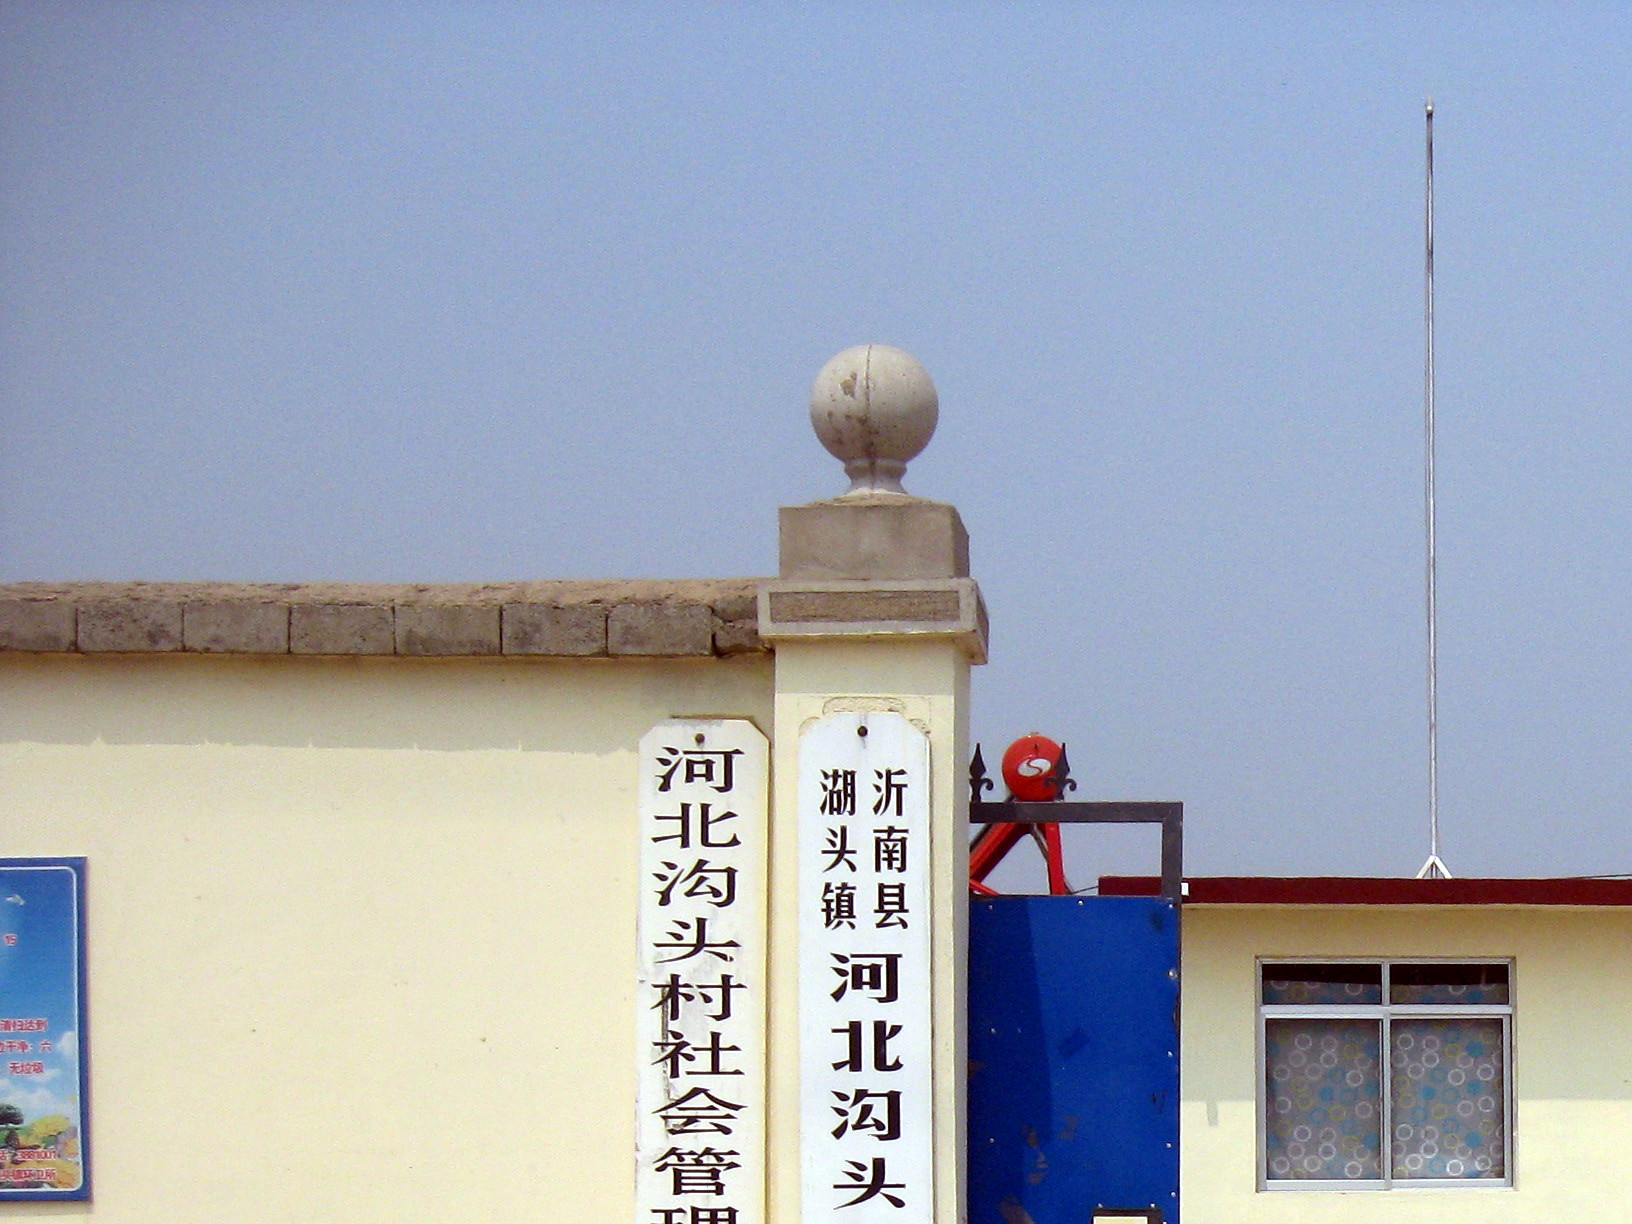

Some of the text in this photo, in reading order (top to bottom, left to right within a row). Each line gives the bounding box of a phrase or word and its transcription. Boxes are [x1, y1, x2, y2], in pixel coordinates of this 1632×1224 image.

[819, 768, 858, 931] 湖头镇
[872, 768, 910, 930] 沂南县
